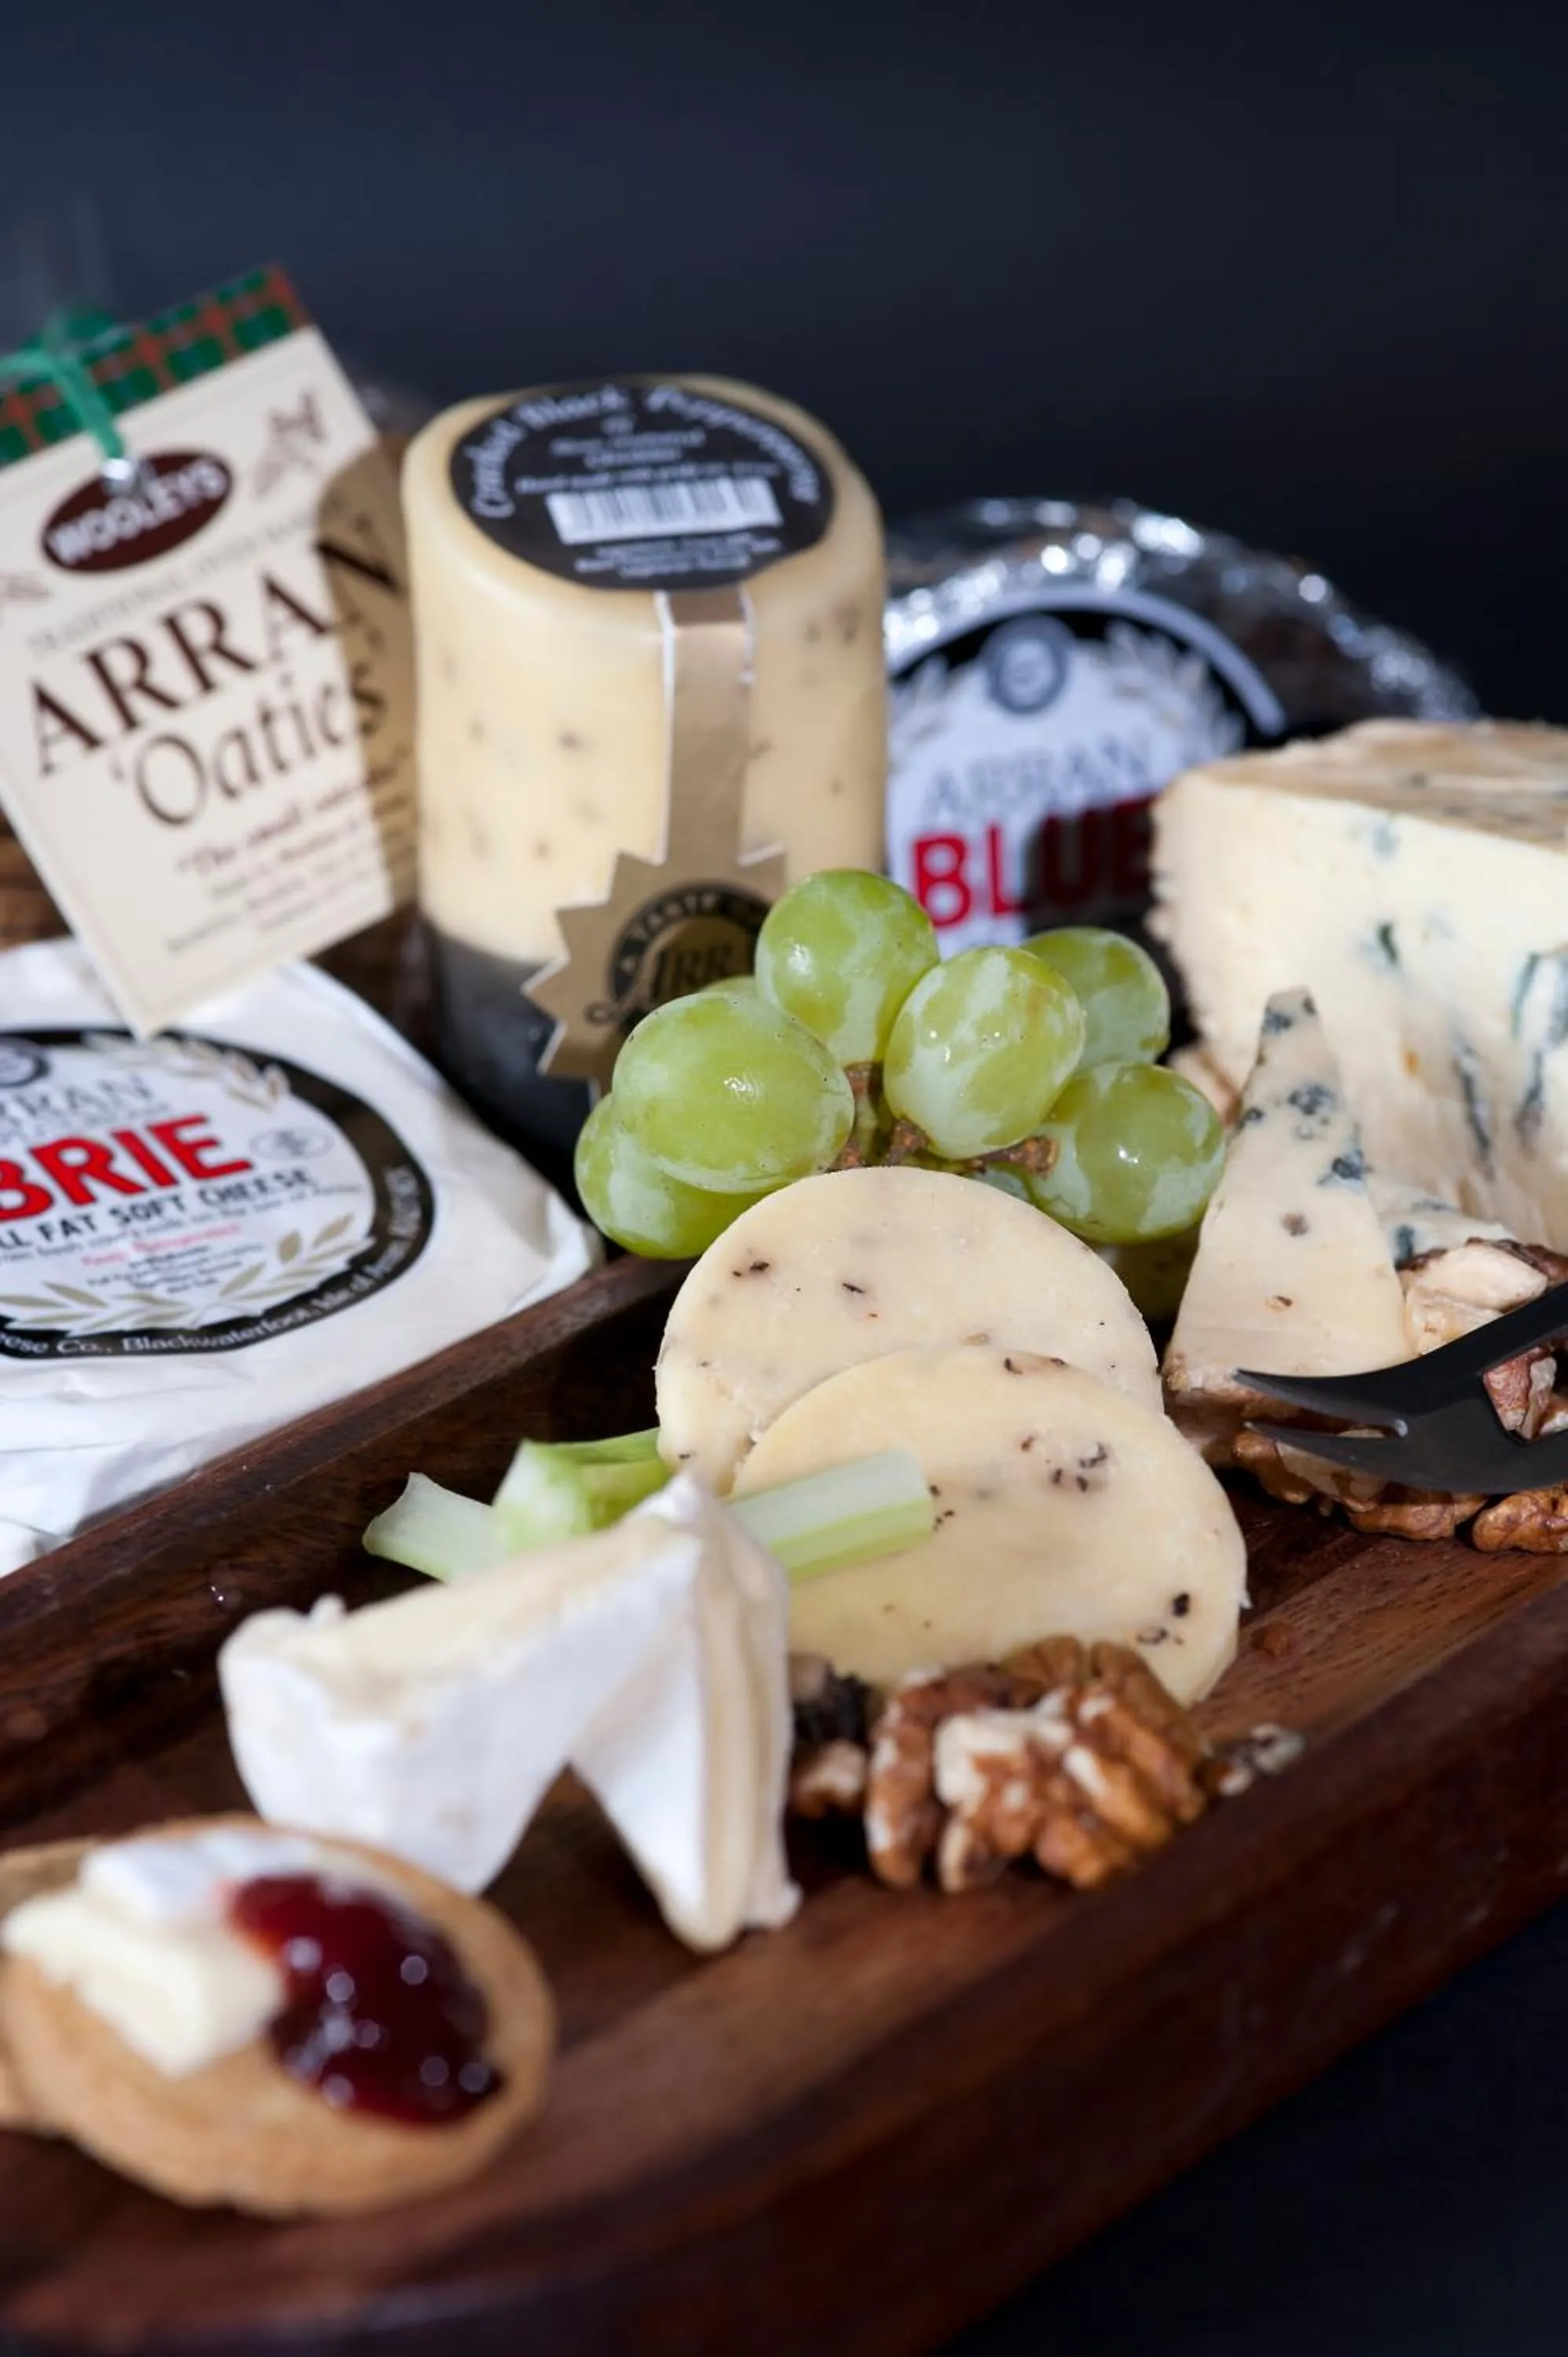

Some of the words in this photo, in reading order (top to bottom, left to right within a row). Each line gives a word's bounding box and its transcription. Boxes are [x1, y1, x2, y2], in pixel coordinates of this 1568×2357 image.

[28, 513, 404, 776] ARRAN
[913, 788, 1155, 928] BLUE
[0, 1115, 254, 1222] BRIE
[37, 1213, 97, 1244] FAT
[108, 1192, 187, 1227] SOFT
[198, 1168, 311, 1208] CHEESE
[0, 1335, 49, 1354] ese
